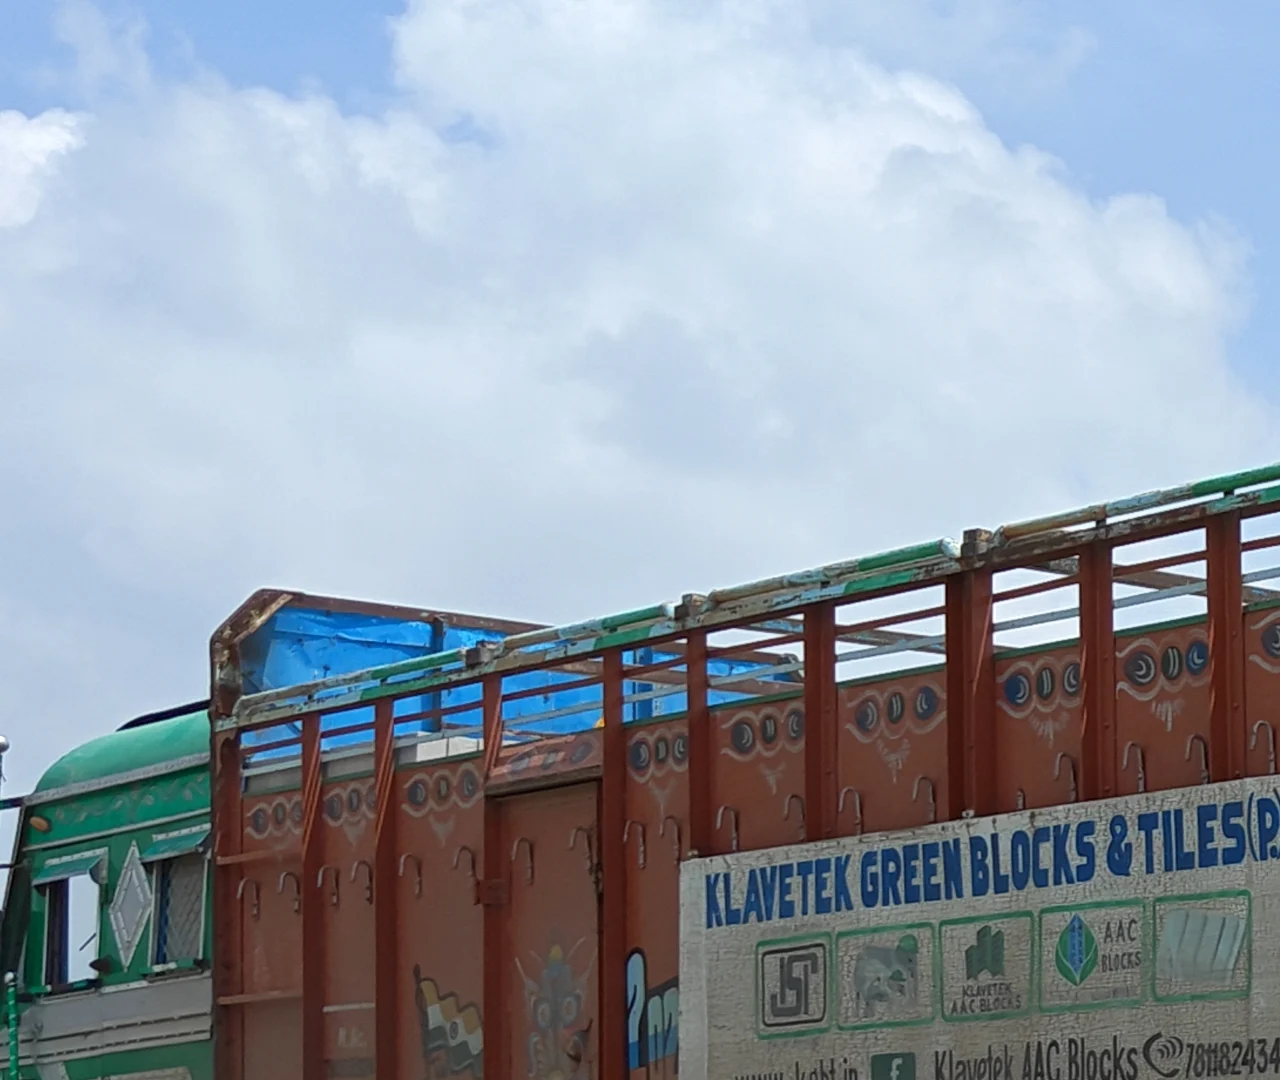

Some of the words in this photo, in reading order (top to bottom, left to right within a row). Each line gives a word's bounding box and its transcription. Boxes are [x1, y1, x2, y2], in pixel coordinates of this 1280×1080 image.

[706, 854, 854, 930] KLAVETEK
[860, 837, 964, 909] GREEN
[969, 820, 1096, 897] BLOCKS
[1106, 814, 1133, 877] &
[1104, 918, 1138, 944] AAC
[1101, 951, 1142, 973] BLOCKS
